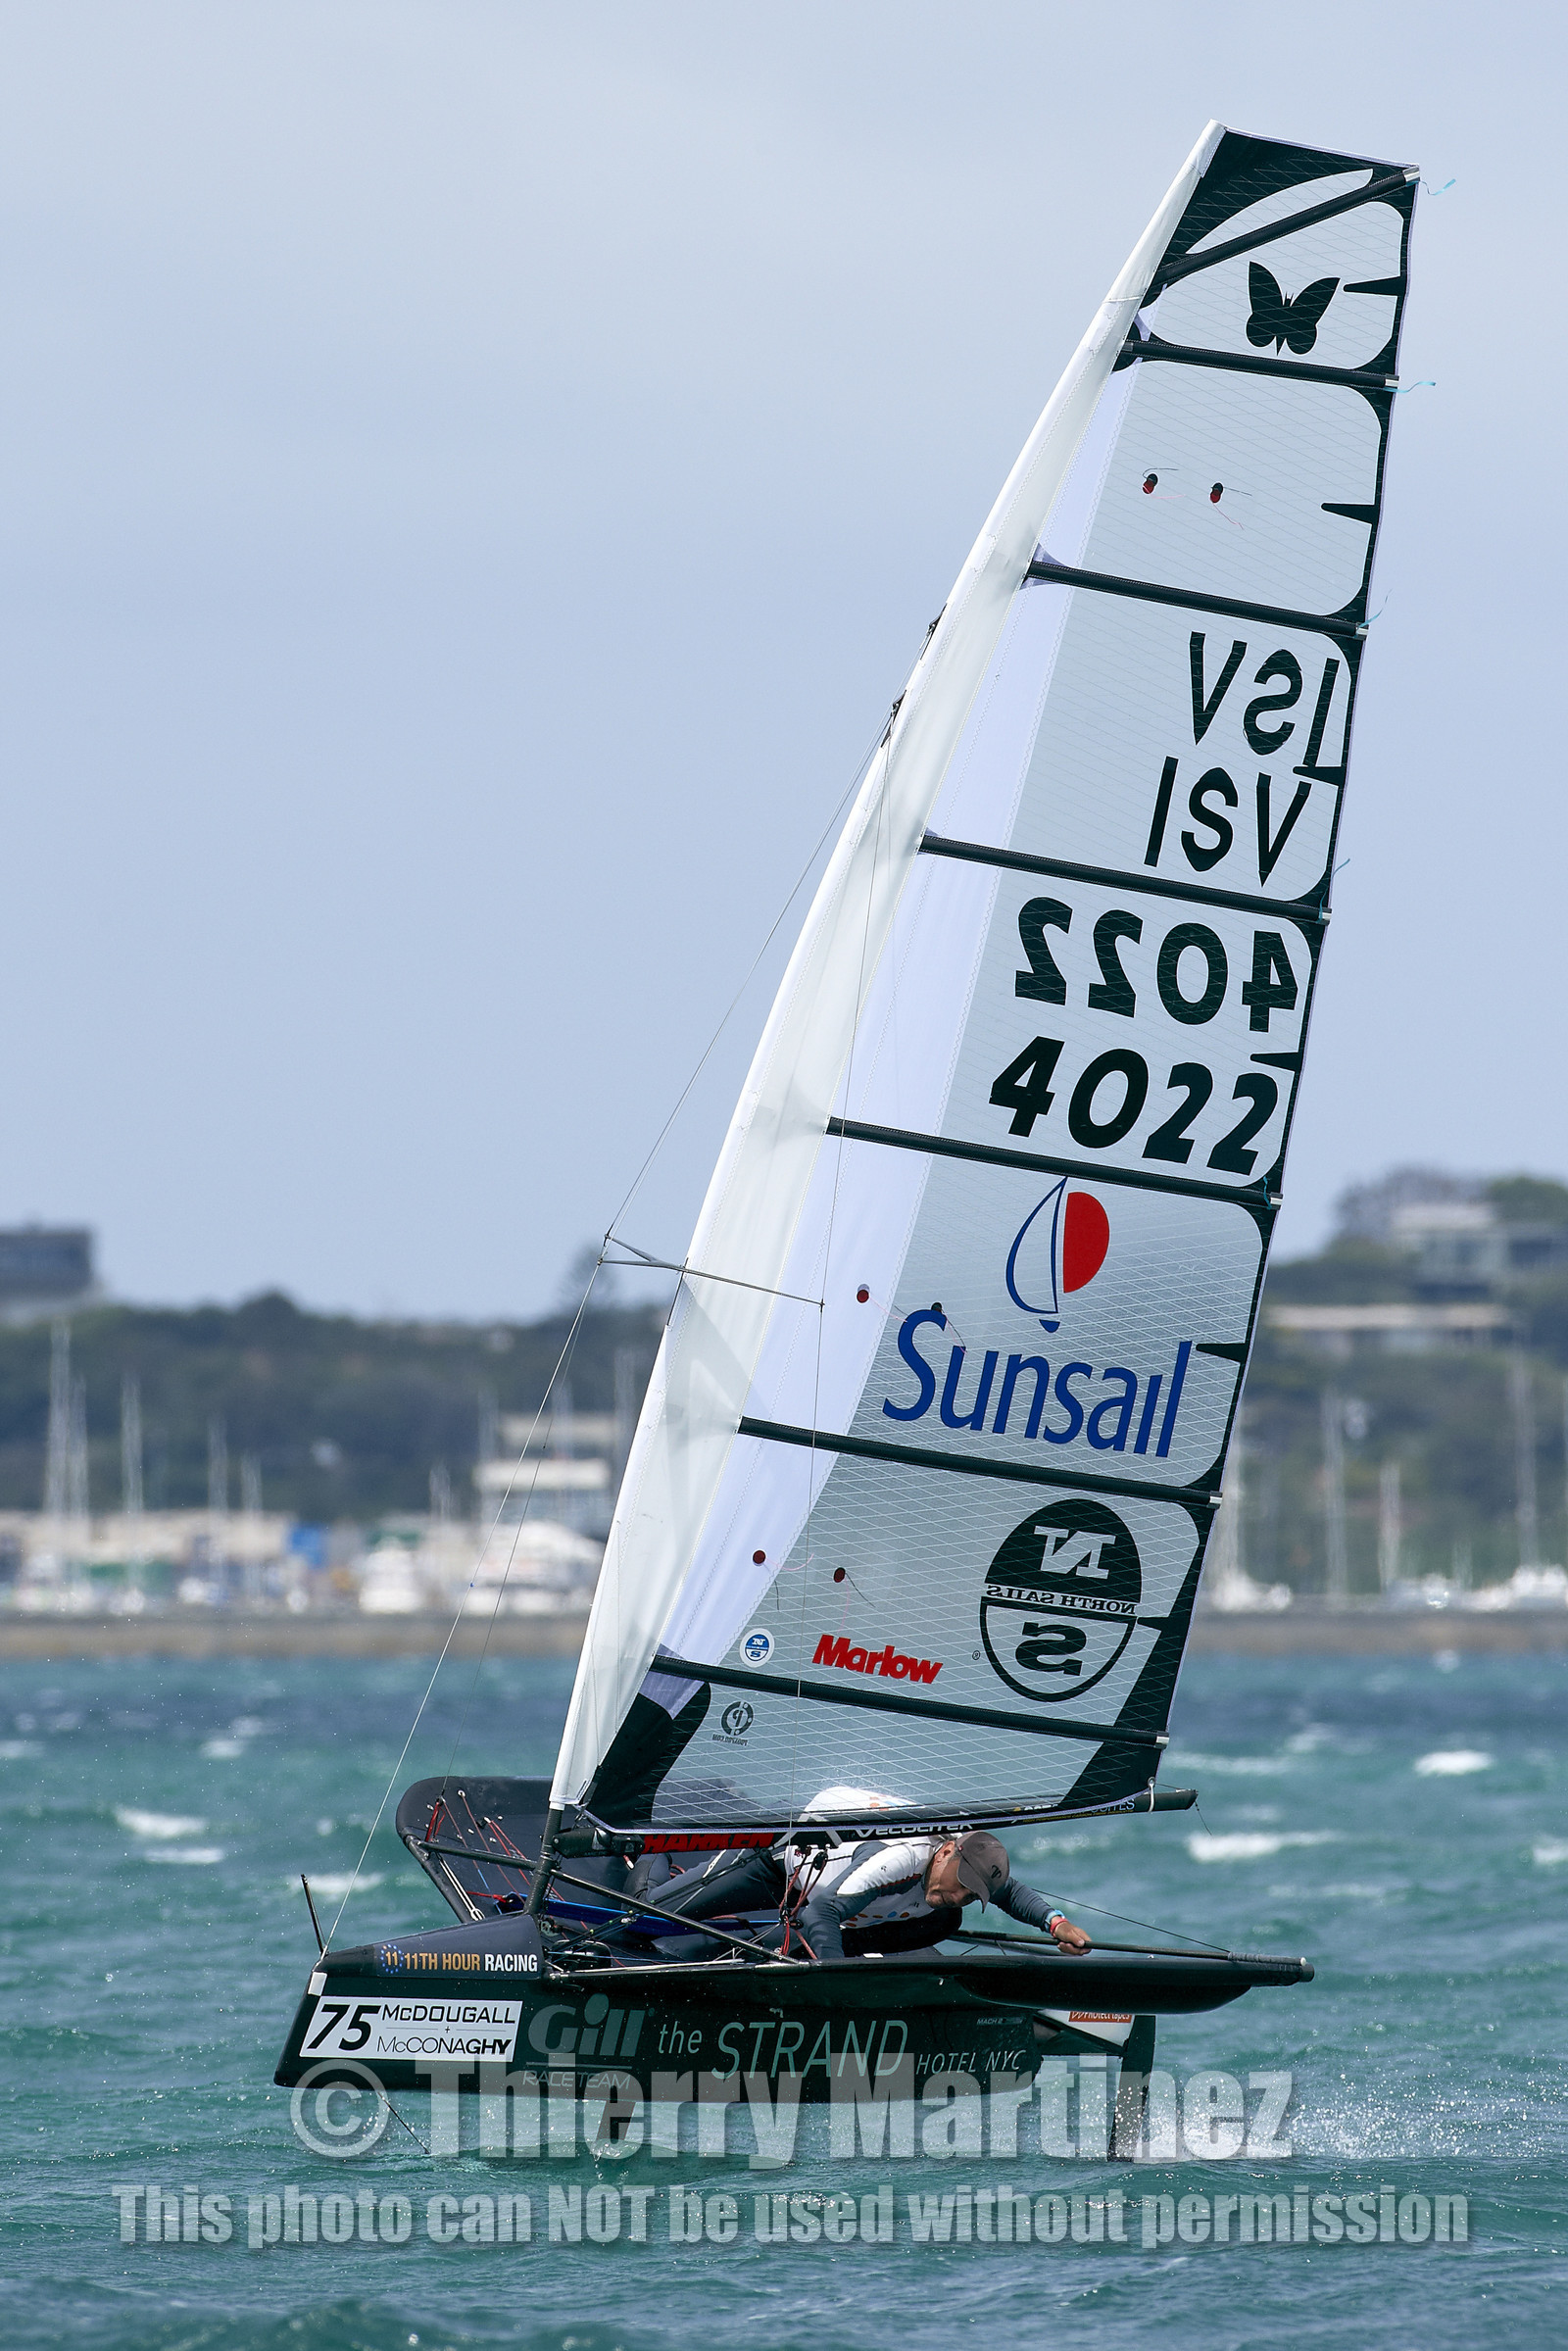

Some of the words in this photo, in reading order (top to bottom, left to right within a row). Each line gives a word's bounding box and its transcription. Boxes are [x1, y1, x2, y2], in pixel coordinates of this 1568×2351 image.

[1144, 756, 1311, 887] ISV
[989, 1036, 1278, 1176] 4022
[882, 1308, 1192, 1457] Sunsail
[811, 1634, 944, 1684] Marlow
[385, 1951, 398, 1966] 11
[404, 1952, 438, 1970] 11TH
[442, 1953, 480, 1971] HOUR
[484, 1953, 538, 1972] RACING
[307, 2003, 381, 2051] 75
[376, 2035, 513, 2054] McCONAGHY
[528, 1992, 646, 2057] Gill
[658, 2012, 703, 2054] the
[710, 2020, 908, 2080] STRAND
[915, 2052, 977, 2075] HOTEL
[985, 2049, 1027, 2072] NYC
